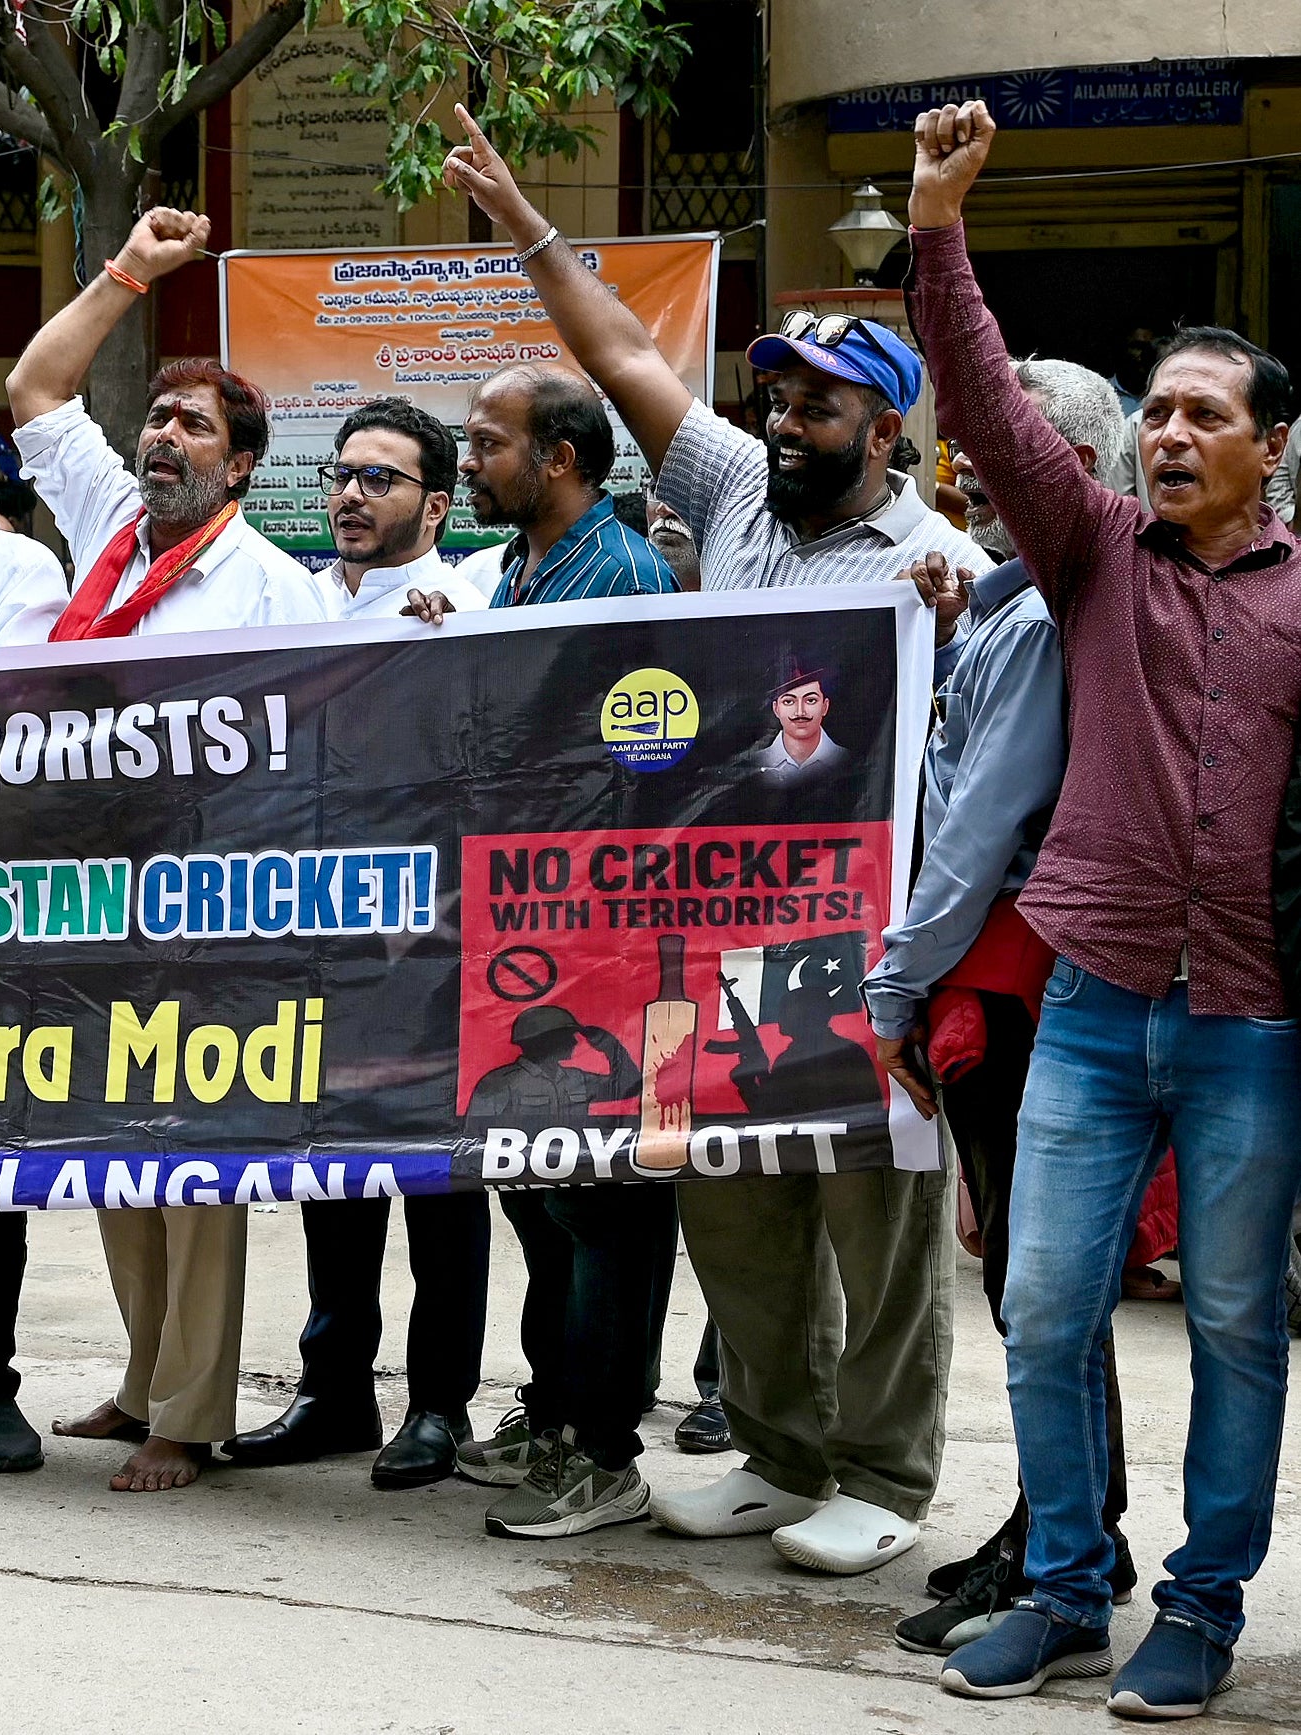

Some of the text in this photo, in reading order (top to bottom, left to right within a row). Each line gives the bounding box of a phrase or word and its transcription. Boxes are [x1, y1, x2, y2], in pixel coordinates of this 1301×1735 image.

[837, 85, 987, 105] SHOYAB HALL
[1074, 80, 1240, 100] AILAMMA ART GALLERY
[264, 694, 289, 772] !
[609, 687, 689, 740] aap
[611, 741, 689, 753] AAM AADMI PARTY
[627, 752, 672, 762] TELANGANA
[489, 837, 863, 896] NO CRICKET
[138, 844, 438, 941] CRICKET!
[490, 890, 863, 932] WITH TERRORISTS!
[104, 997, 325, 1104] Modi
